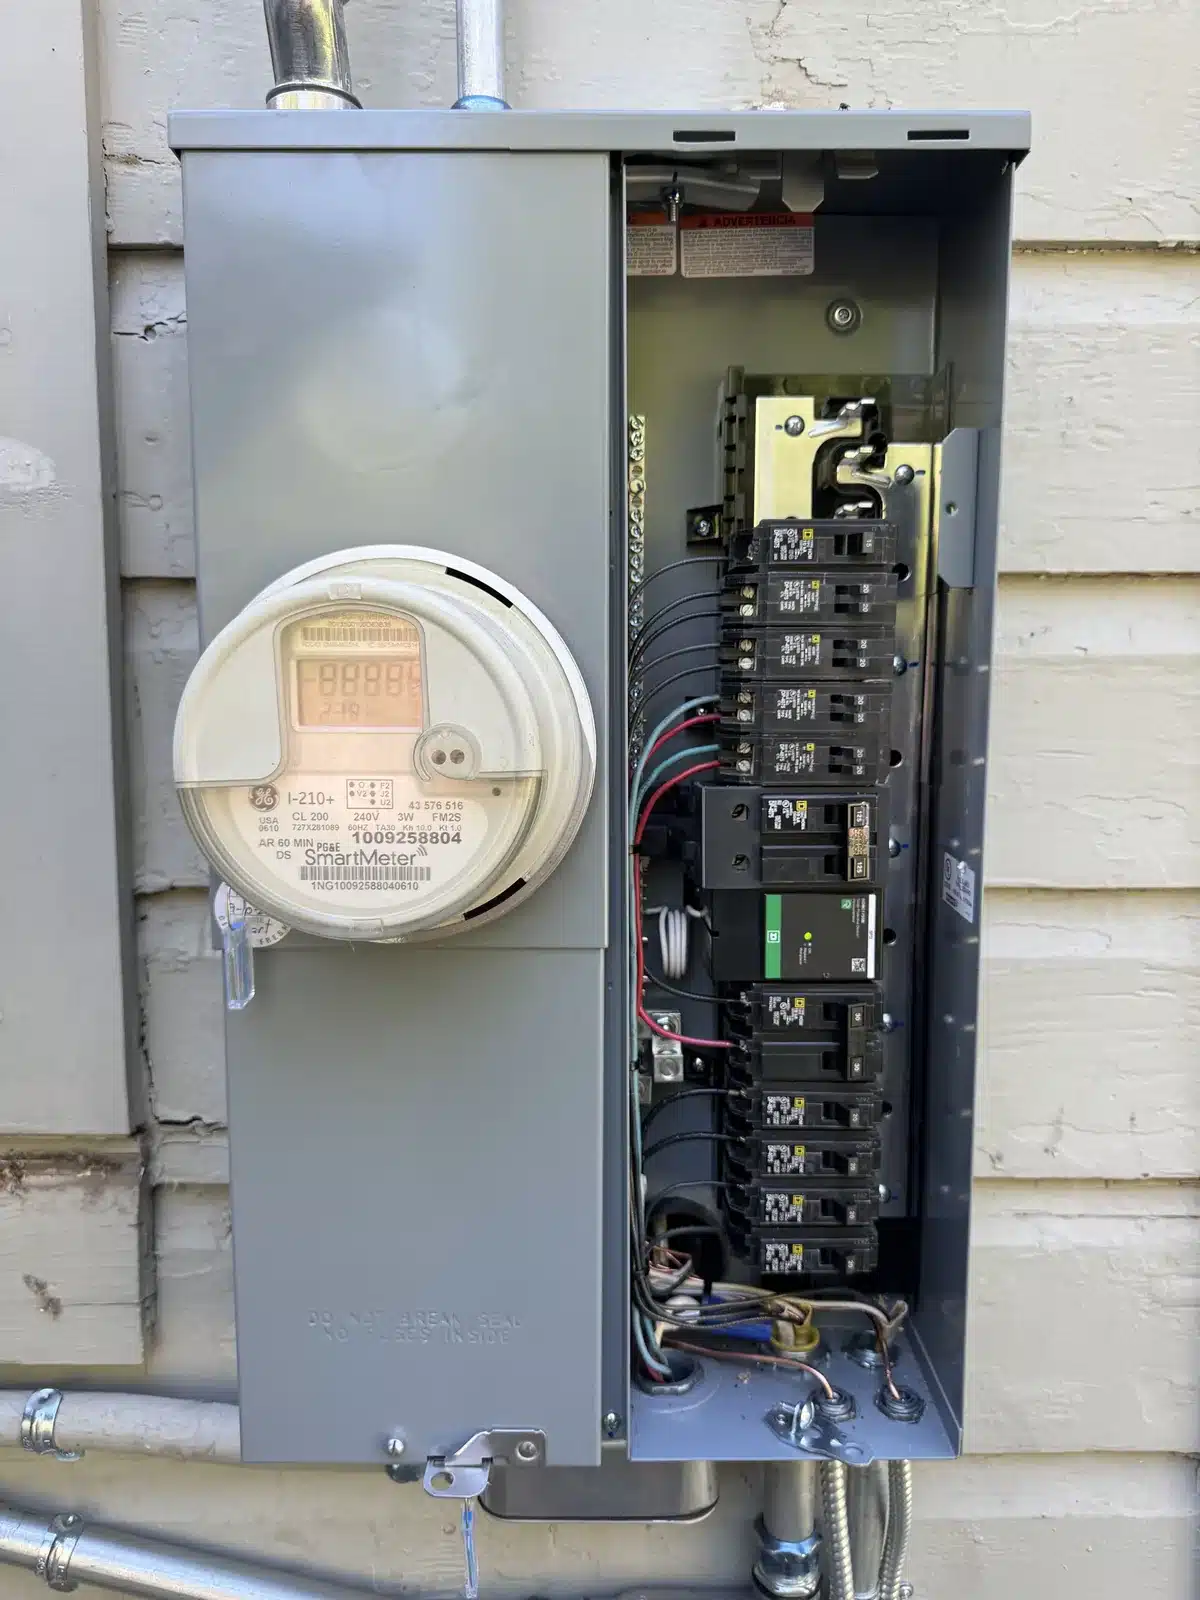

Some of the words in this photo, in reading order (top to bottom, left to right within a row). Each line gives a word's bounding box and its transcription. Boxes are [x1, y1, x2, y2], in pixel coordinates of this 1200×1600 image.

[862, 584, 869, 593] 20
[862, 604, 869, 612] 20
[860, 640, 867, 648] 20
[859, 658, 866, 668] 20
[858, 696, 864, 705] 20
[858, 714, 864, 722] 20
[856, 749, 863, 758] 20
[856, 766, 863, 775] 20
[288, 792, 335, 804] I-210+
[408, 801, 420, 810] 43
[424, 801, 442, 810] 576
[445, 801, 464, 810] 516
[258, 816, 279, 824] USA
[292, 812, 307, 820] CL
[310, 812, 329, 820] 200
[354, 812, 380, 821] 240V
[398, 812, 414, 821] 3W
[432, 813, 462, 822] FM2S
[352, 831, 462, 844] 1009258804
[258, 838, 274, 848] AR
[278, 838, 290, 848] 60
[294, 838, 314, 848] MIN
[316, 842, 340, 852] PG&E
[276, 850, 292, 860] DS
[304, 848, 417, 866] SmartMeter
[311, 881, 419, 891] 1NG10092588040610
